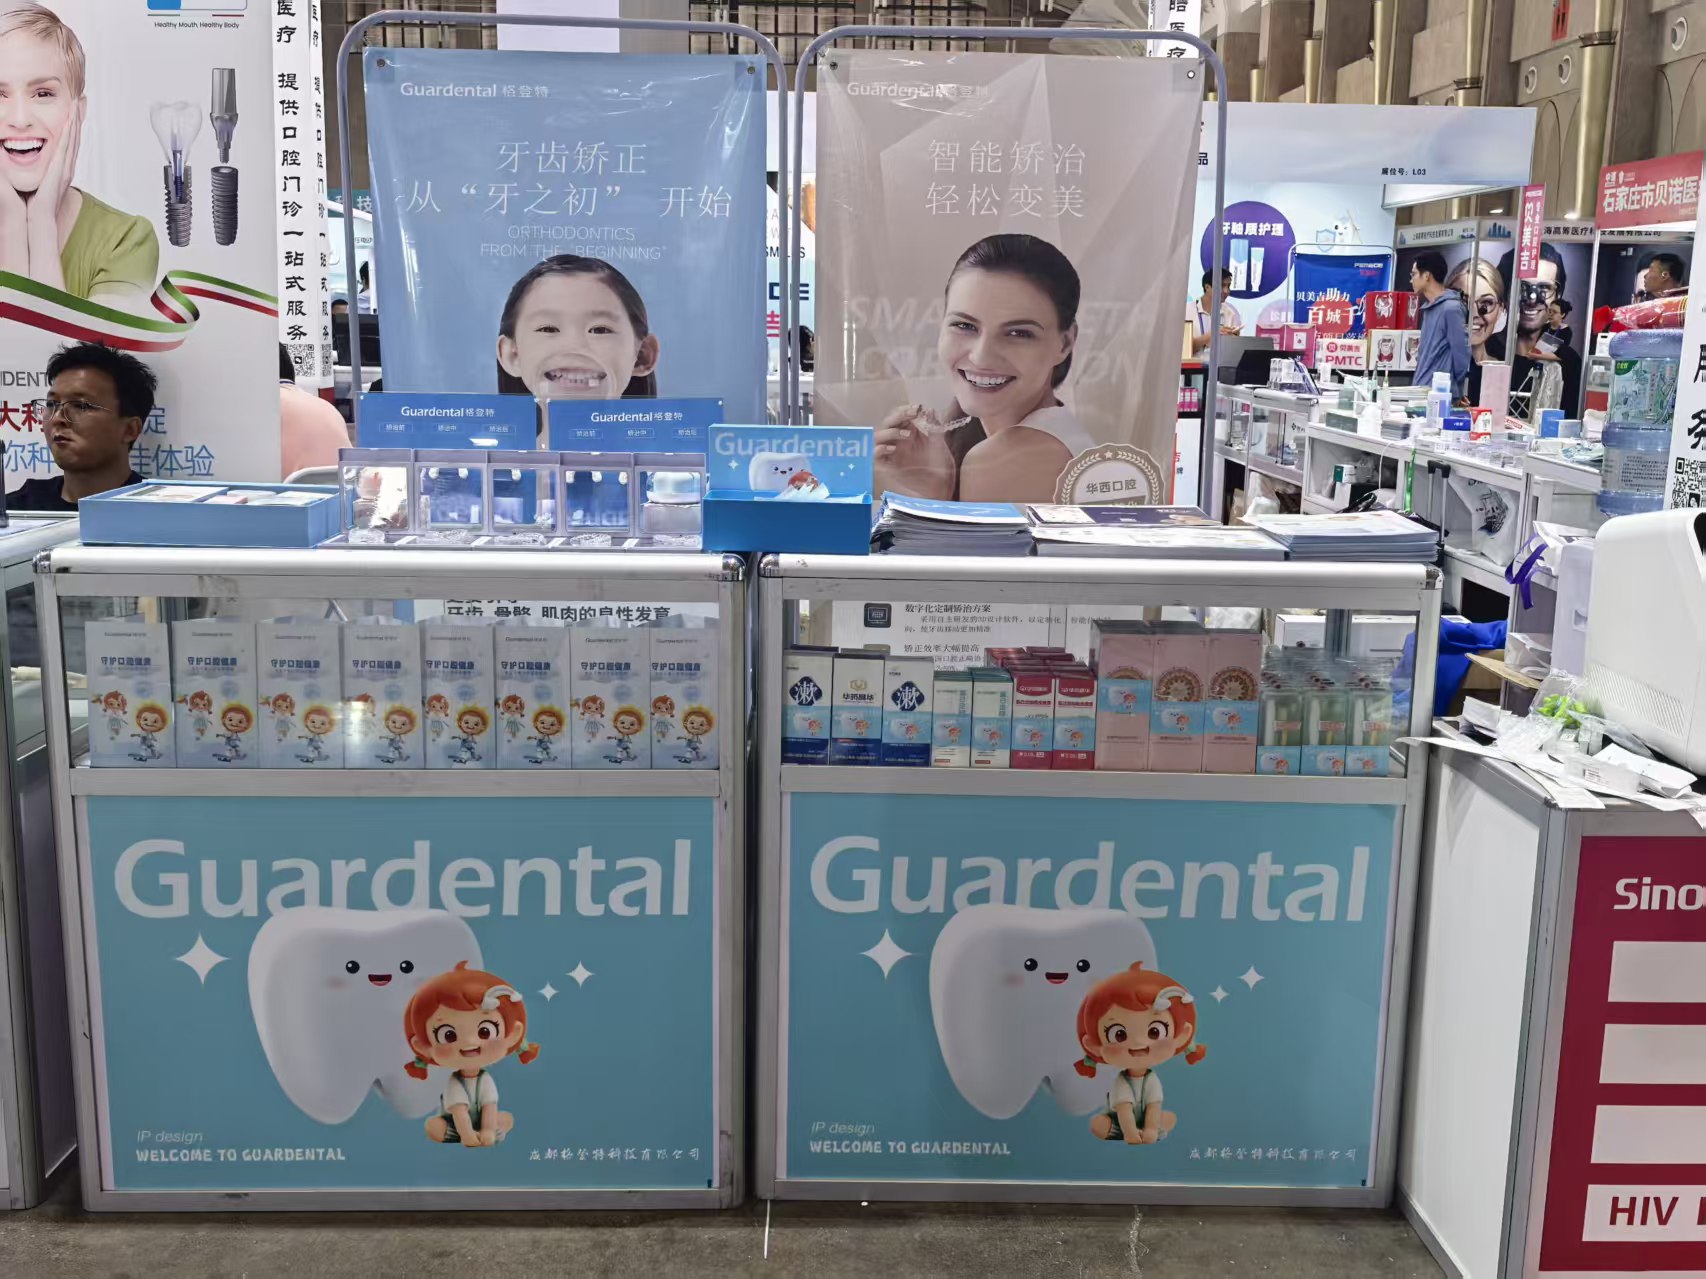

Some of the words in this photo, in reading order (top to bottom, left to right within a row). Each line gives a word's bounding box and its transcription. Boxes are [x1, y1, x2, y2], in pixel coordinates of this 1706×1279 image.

[400, 82, 497, 97] Guardental
[502, 85, 549, 98] 格登特
[496, 141, 648, 175] 牙齿矫正
[928, 139, 1086, 177] 智能矫治
[405, 180, 442, 213] 从
[659, 186, 733, 219] 开始
[925, 181, 1085, 219] 轻松变美
[1603, 176, 1701, 213] 石家庄市贝诺医
[278, 73, 308, 341] 提供口腔门诊一站式服务
[507, 225, 636, 241] ORTHODONTICS
[480, 243, 526, 258] FROM
[1307, 304, 1366, 326] 百城千
[1325, 356, 1362, 366] PMTC
[401, 406, 464, 417] Guardental
[466, 408, 495, 417] 格登特
[591, 412, 653, 422] Guardental
[654, 412, 683, 421] 格登特
[714, 432, 868, 457] Guardental
[1086, 478, 1137, 494] 华西口腔
[904, 644, 980, 653] 矫正效率大幅提高
[795, 680, 819, 704] 漱
[897, 685, 921, 710] 漱
[113, 839, 692, 919] Guardental
[809, 835, 1370, 922] Guardental
[1613, 876, 1706, 910] Sino
[137, 1130, 151, 1142] IP
[155, 1130, 203, 1144] design
[811, 1121, 825, 1134] IP
[829, 1122, 875, 1136] design
[136, 1149, 212, 1162] WELCOME
[217, 1149, 237, 1162] TO
[242, 1148, 346, 1162] GUARDENTAL
[810, 1141, 882, 1153] WELCOME
[888, 1141, 906, 1153] TO
[911, 1142, 1011, 1155] GUARDENTAL
[1609, 1196, 1679, 1226] HIV
